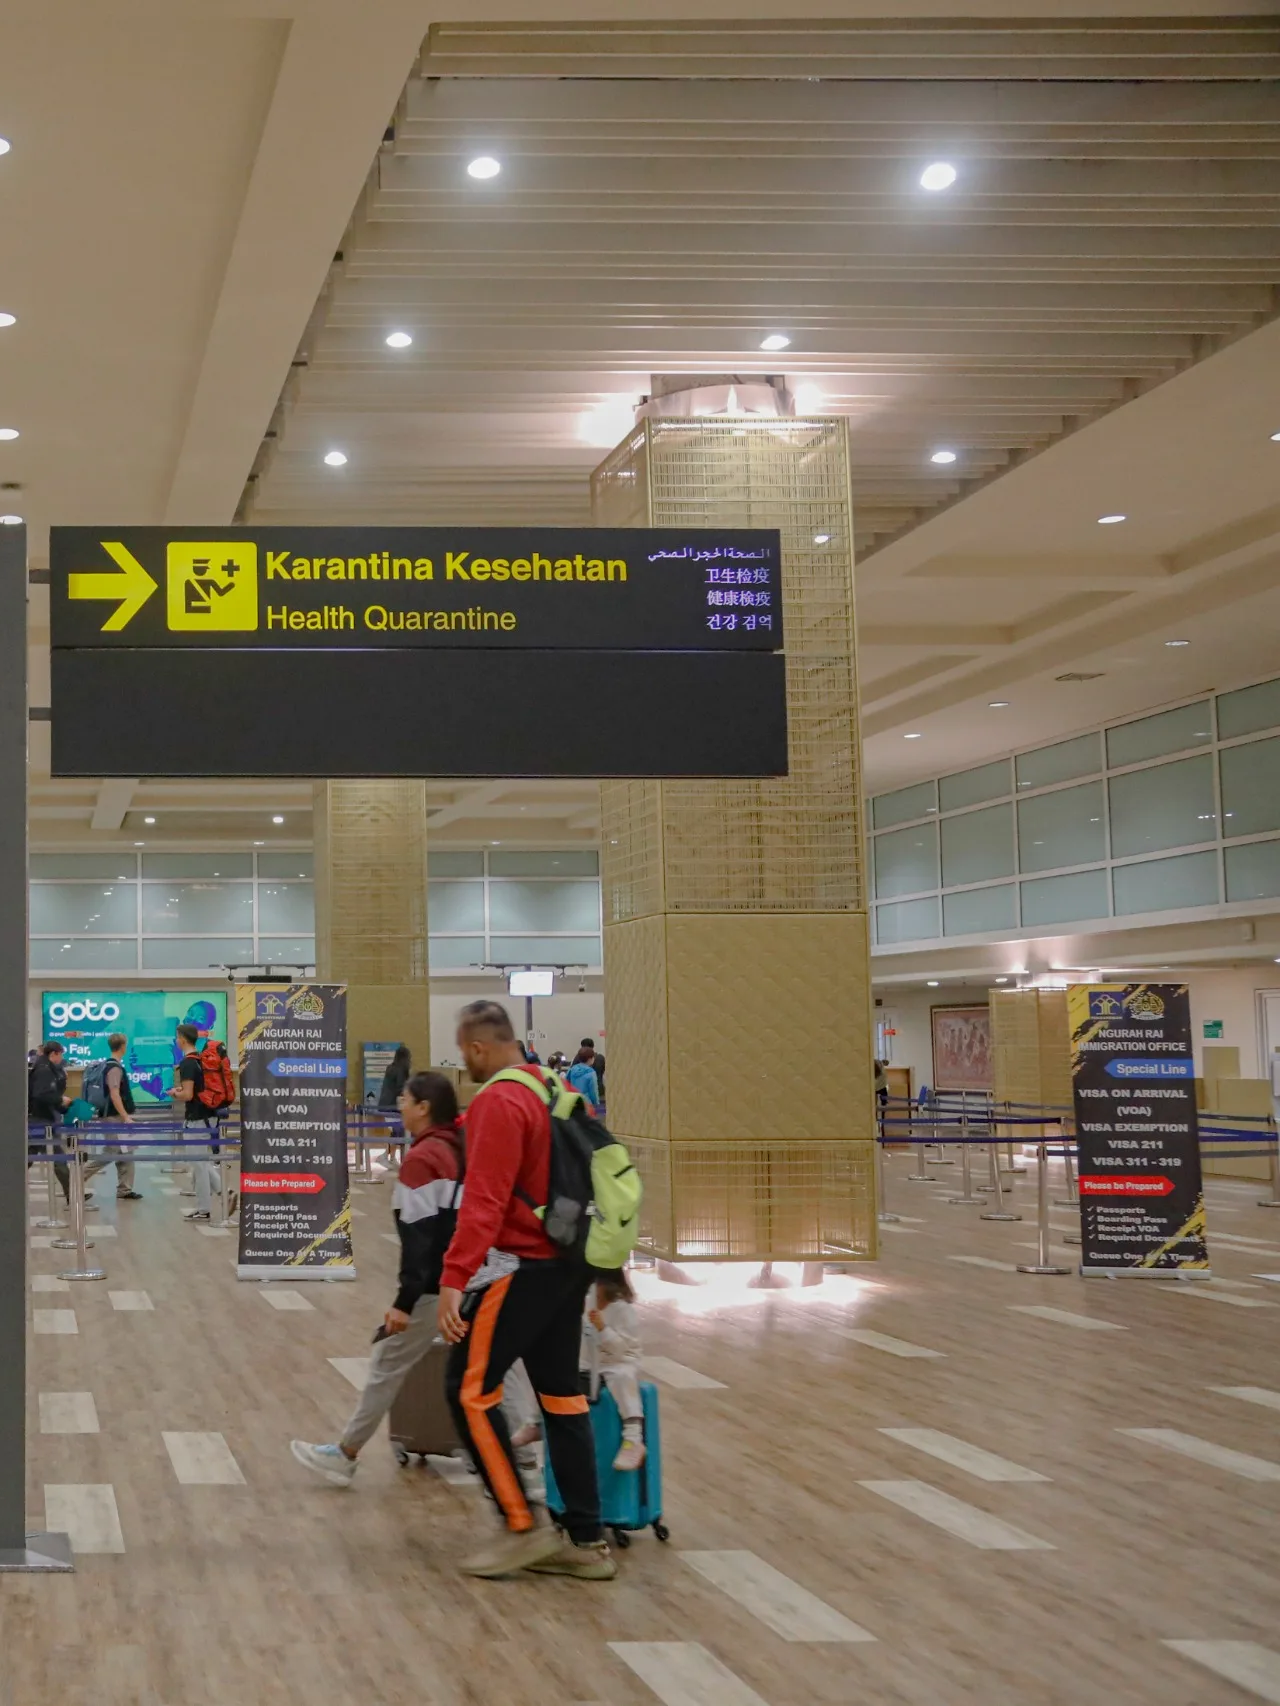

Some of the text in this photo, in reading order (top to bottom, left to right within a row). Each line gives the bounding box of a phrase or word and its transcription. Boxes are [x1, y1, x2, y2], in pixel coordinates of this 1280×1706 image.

[266, 551, 627, 581] Karantina Kesehatan
[705, 568, 770, 584] 卫生检疫
[706, 590, 771, 607] 健康検疫
[267, 605, 517, 632] Health Quarantine
[706, 613, 772, 631] 건강 검역
[49, 999, 120, 1028] goto
[263, 1029, 322, 1038] NGURAH RAI
[1098, 1029, 1163, 1038] NGURAH RAI
[69, 1043, 91, 1056] Far,
[244, 1041, 342, 1051] IMMIGRATION OFFICE
[1078, 1042, 1186, 1051] IMMIGRATION OFFICE
[278, 1063, 342, 1075] Special Line
[1117, 1064, 1187, 1076] Special Line
[243, 1088, 341, 1097] VISA ON ARRIVAL
[1079, 1089, 1187, 1098] VISA ON ARRIVAL
[276, 1104, 308, 1115] (VOA)
[1117, 1106, 1152, 1117] (VOA)
[244, 1121, 340, 1130] VISA EXEMPTION
[1082, 1123, 1188, 1132] VISA EXEMPTION
[267, 1138, 317, 1147] VISA 211
[1108, 1140, 1163, 1149] VISA 211
[252, 1155, 280, 1164] VISA
[282, 1155, 302, 1164] 311
[313, 1155, 333, 1164] 319
[1092, 1157, 1124, 1166] VISA
[1126, 1157, 1148, 1166] 311
[1159, 1158, 1181, 1166] 319
[244, 1179, 316, 1188] Please be Prepared
[1084, 1182, 1163, 1191] Please be Prepared
[254, 1204, 298, 1212] Passports
[254, 1213, 294, 1221] Boarding
[1097, 1216, 1142, 1224] Boarding
[1097, 1225, 1136, 1233] Receipt
[1098, 1234, 1142, 1242] Required
[1089, 1252, 1121, 1260] Queue
[1123, 1252, 1143, 1260] One
[1170, 1253, 1194, 1261] Time
